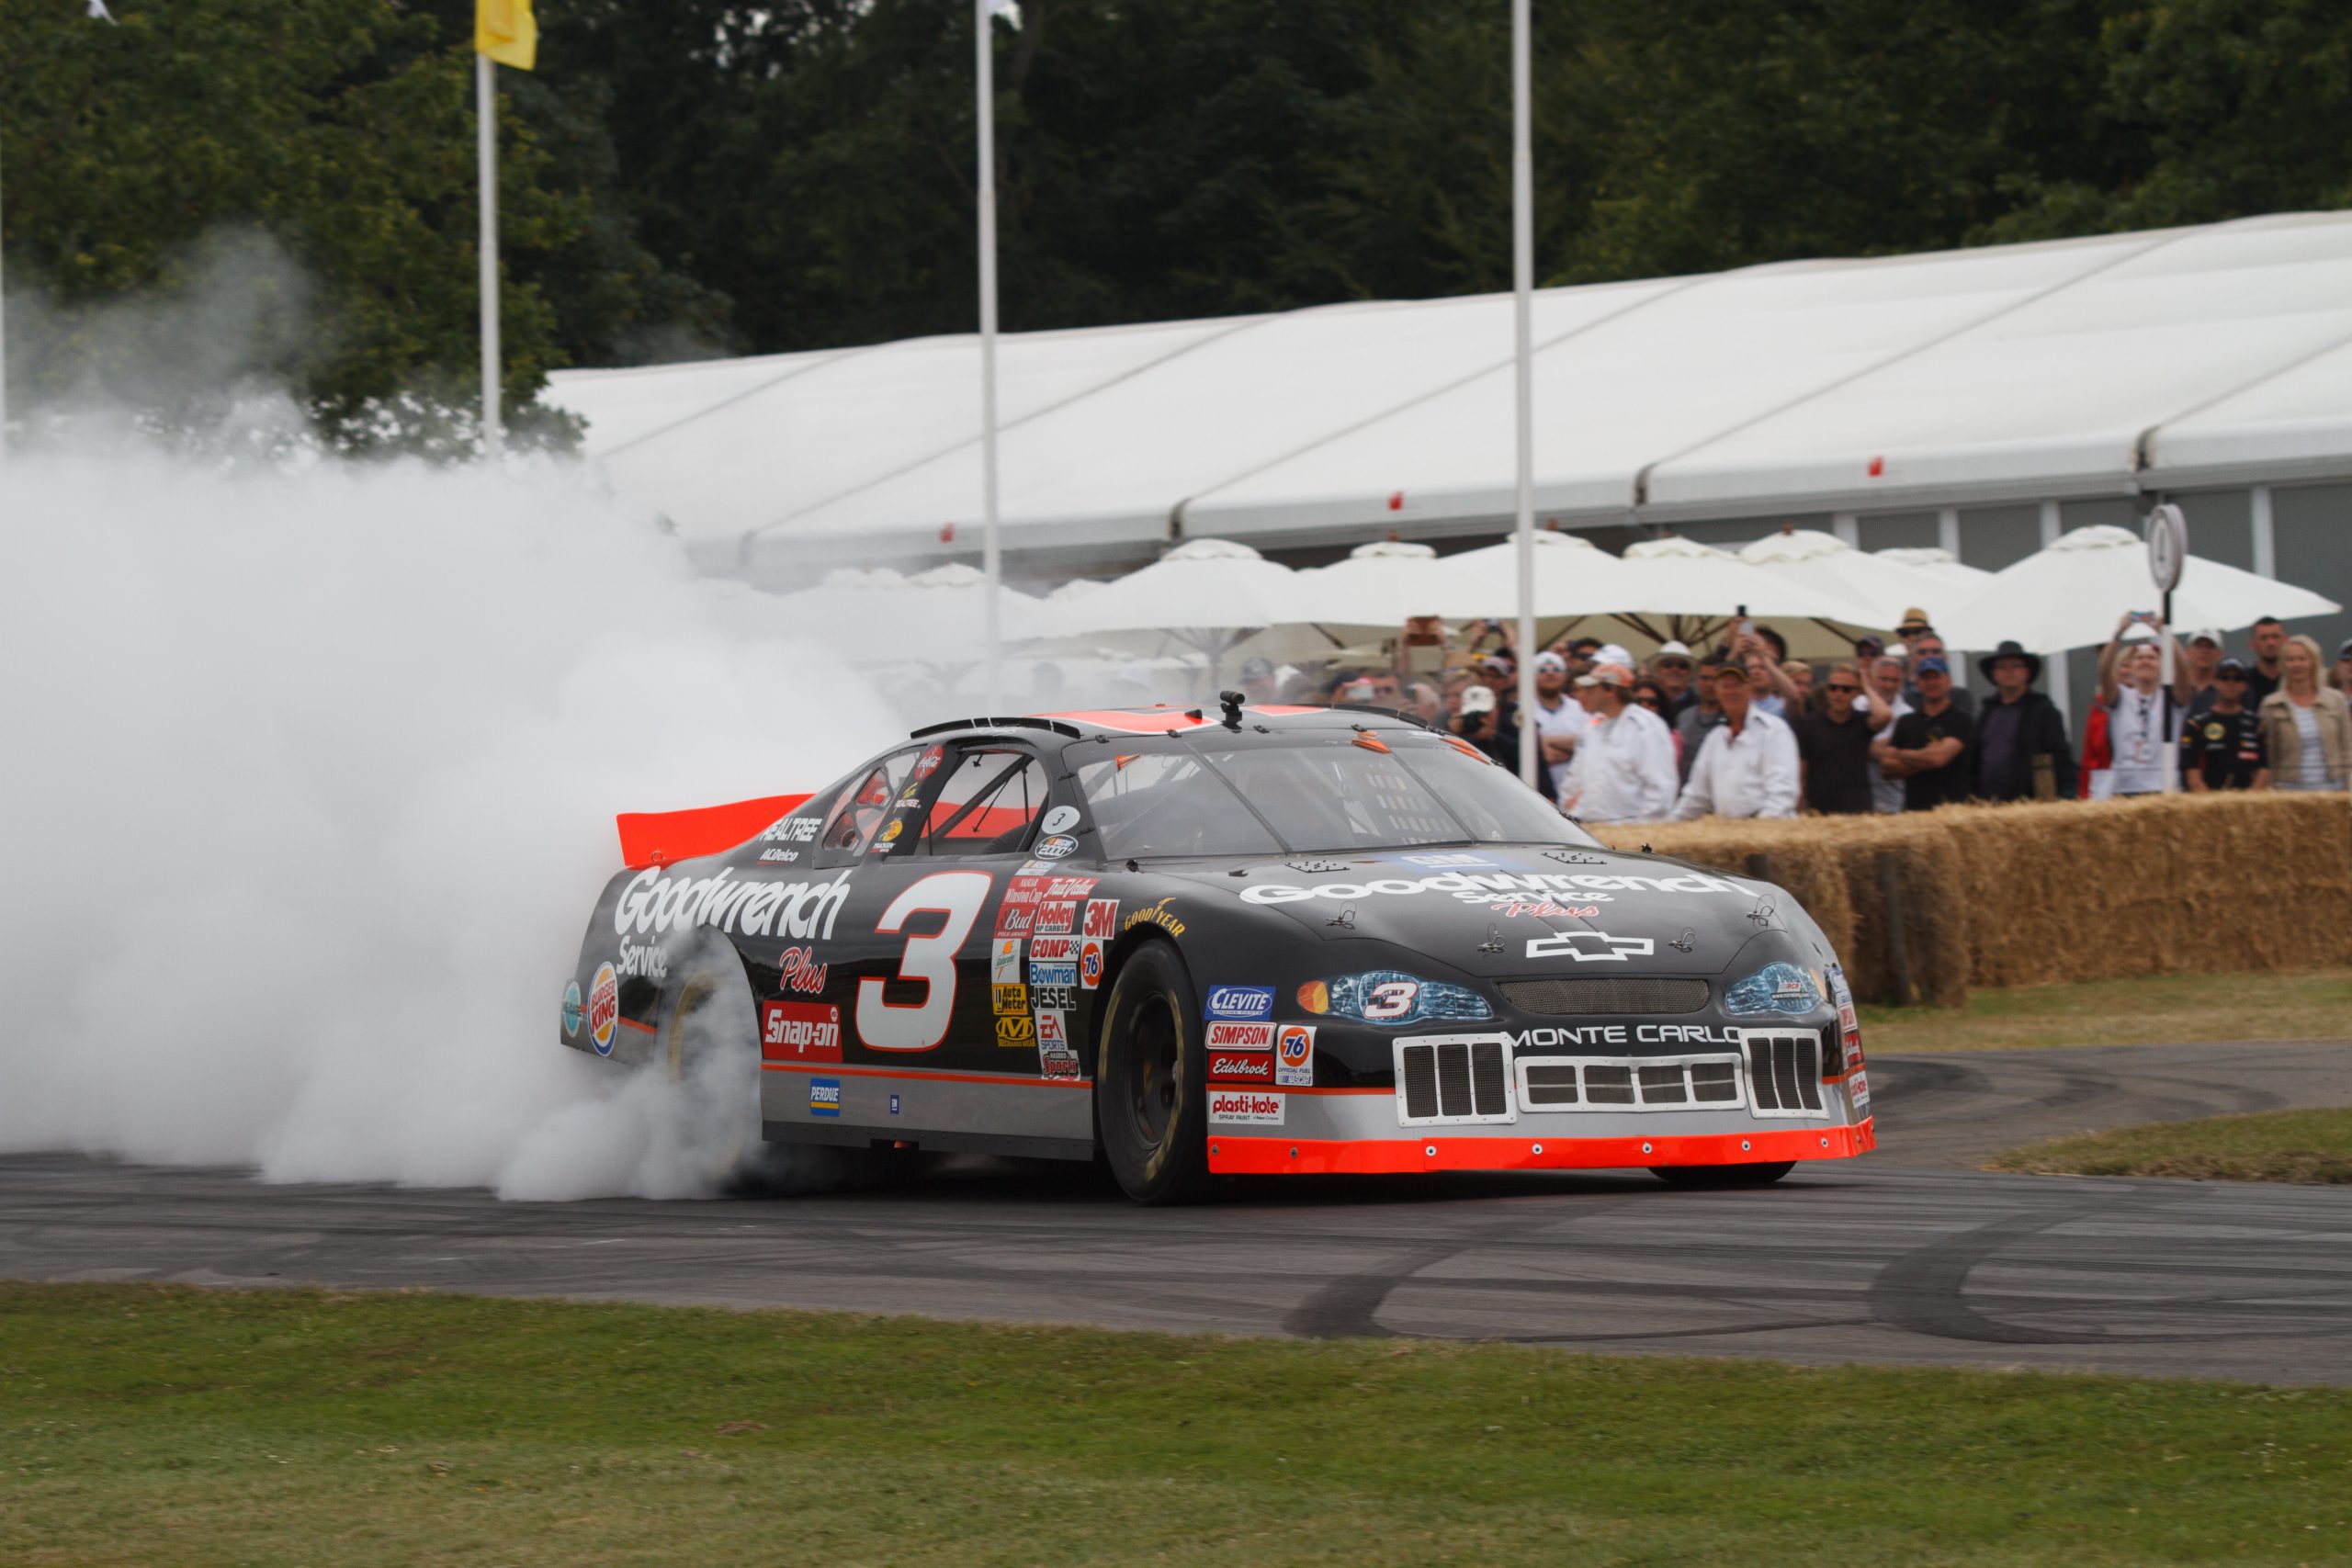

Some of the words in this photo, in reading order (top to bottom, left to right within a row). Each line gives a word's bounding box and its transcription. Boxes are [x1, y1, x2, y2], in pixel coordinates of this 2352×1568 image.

[759, 818, 822, 842] REALTREE
[760, 849, 799, 862] ACDelco
[1038, 844, 1068, 856] 2000
[1401, 853, 1488, 863] GM
[1239, 872, 1761, 904] Goodwrench
[1452, 890, 1615, 904] Service
[615, 866, 853, 940] Goodwrench
[1490, 902, 1600, 917] Plus
[1004, 908, 1035, 930] Bud
[1036, 902, 1074, 931] Holley
[1084, 901, 1115, 937] 3M
[616, 935, 668, 977] Service
[1030, 939, 1069, 958] COMP
[779, 946, 828, 994] Plus
[855, 870, 994, 1053] 3
[1085, 953, 1099, 976] 76
[1030, 964, 1075, 984] Bowman
[591, 979, 616, 1011] BURGER
[1002, 987, 1022, 998] Auto
[1031, 986, 1076, 1010] JESEL
[1212, 988, 1270, 1010] CLEVITE
[1364, 980, 1419, 1019] 3
[1002, 998, 1026, 1010] Meter
[591, 996, 616, 1035] KING
[765, 1010, 839, 1054] Snap-on
[1211, 1026, 1271, 1045] SIMPSON
[1506, 1025, 1627, 1047] MONTE
[1041, 1040, 1065, 1050] SPORTS
[1283, 1034, 1306, 1058] 76
[1043, 1055, 1079, 1074] Sports
[1213, 1058, 1269, 1076] Edelbrock
[811, 1087, 839, 1101] PERDUE
[1213, 1095, 1279, 1113] plasti-kote
